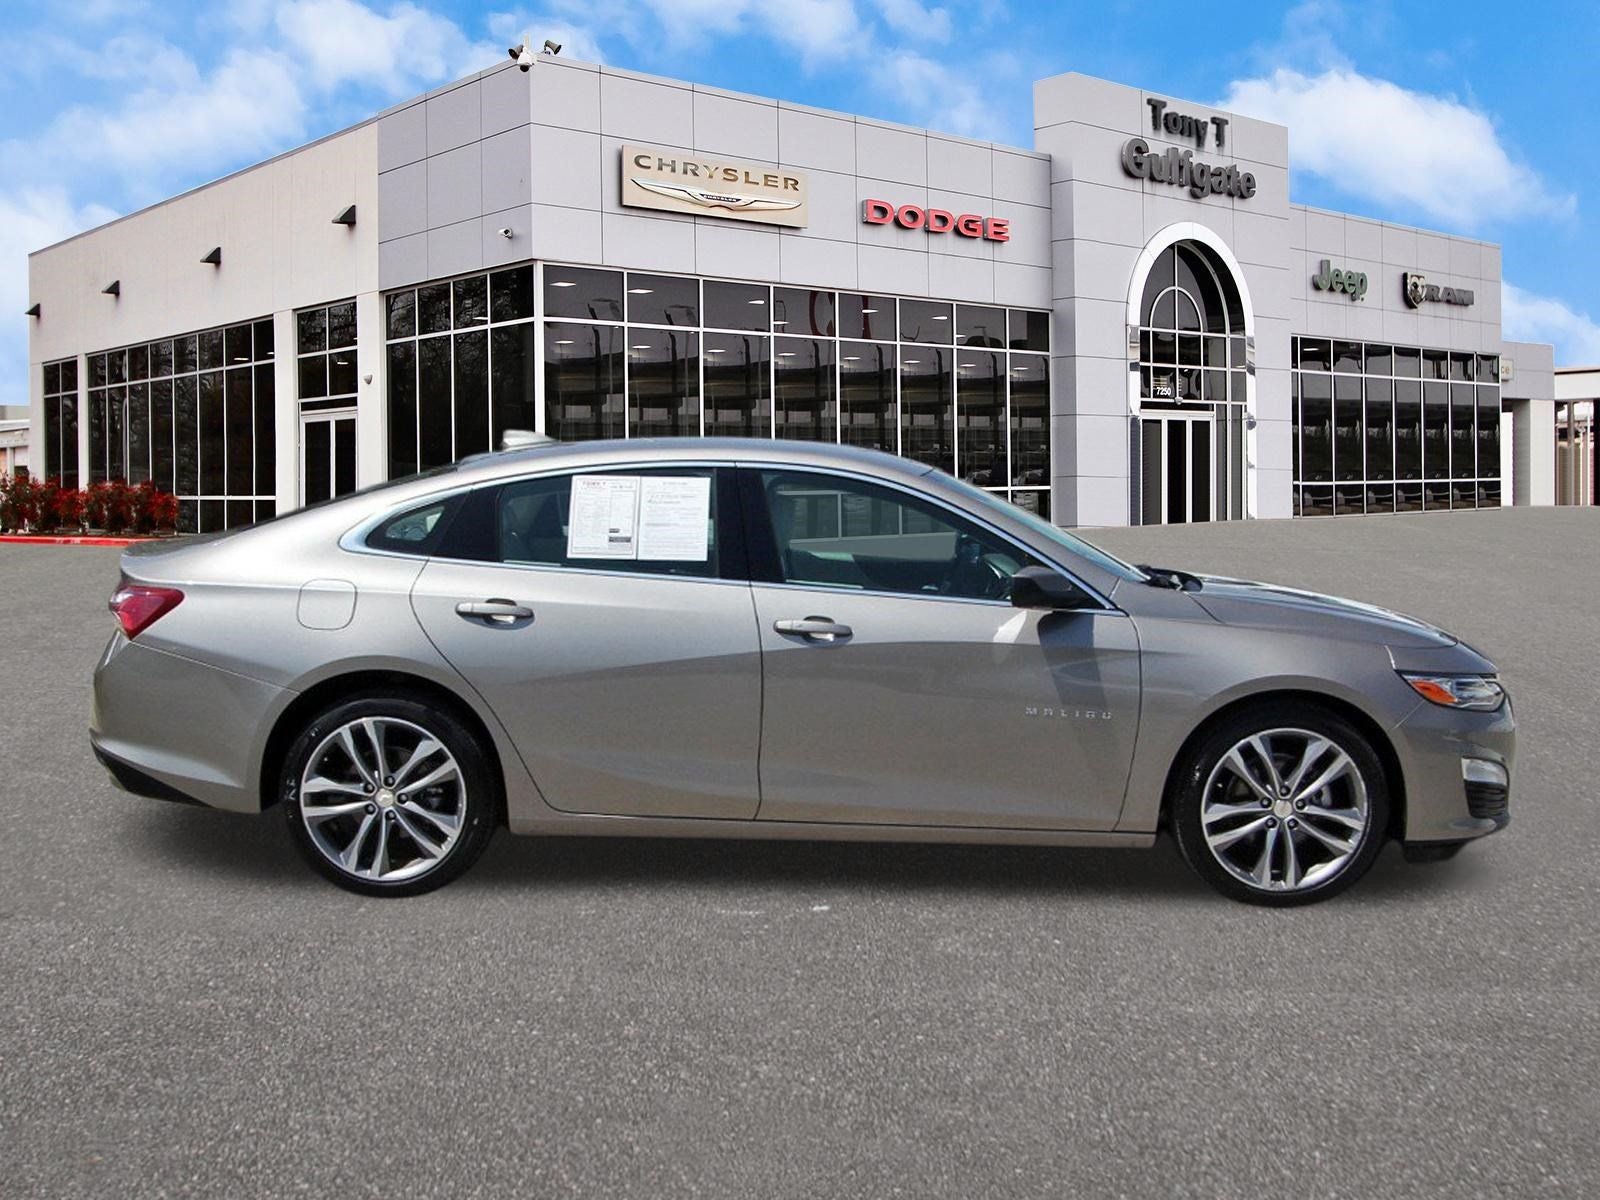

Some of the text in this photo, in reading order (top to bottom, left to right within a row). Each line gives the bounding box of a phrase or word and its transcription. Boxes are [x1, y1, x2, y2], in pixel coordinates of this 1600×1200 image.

[1147, 98, 1229, 147] Tony T
[633, 154, 800, 192] CHRYSLER
[1121, 137, 1257, 199] Gulfgate
[862, 198, 1010, 242] DODGE
[1312, 259, 1368, 302] Jeep
[1424, 283, 1475, 306] RAM
[1156, 386, 1172, 396] 7250
[1025, 706, 1112, 720] MALIBU
